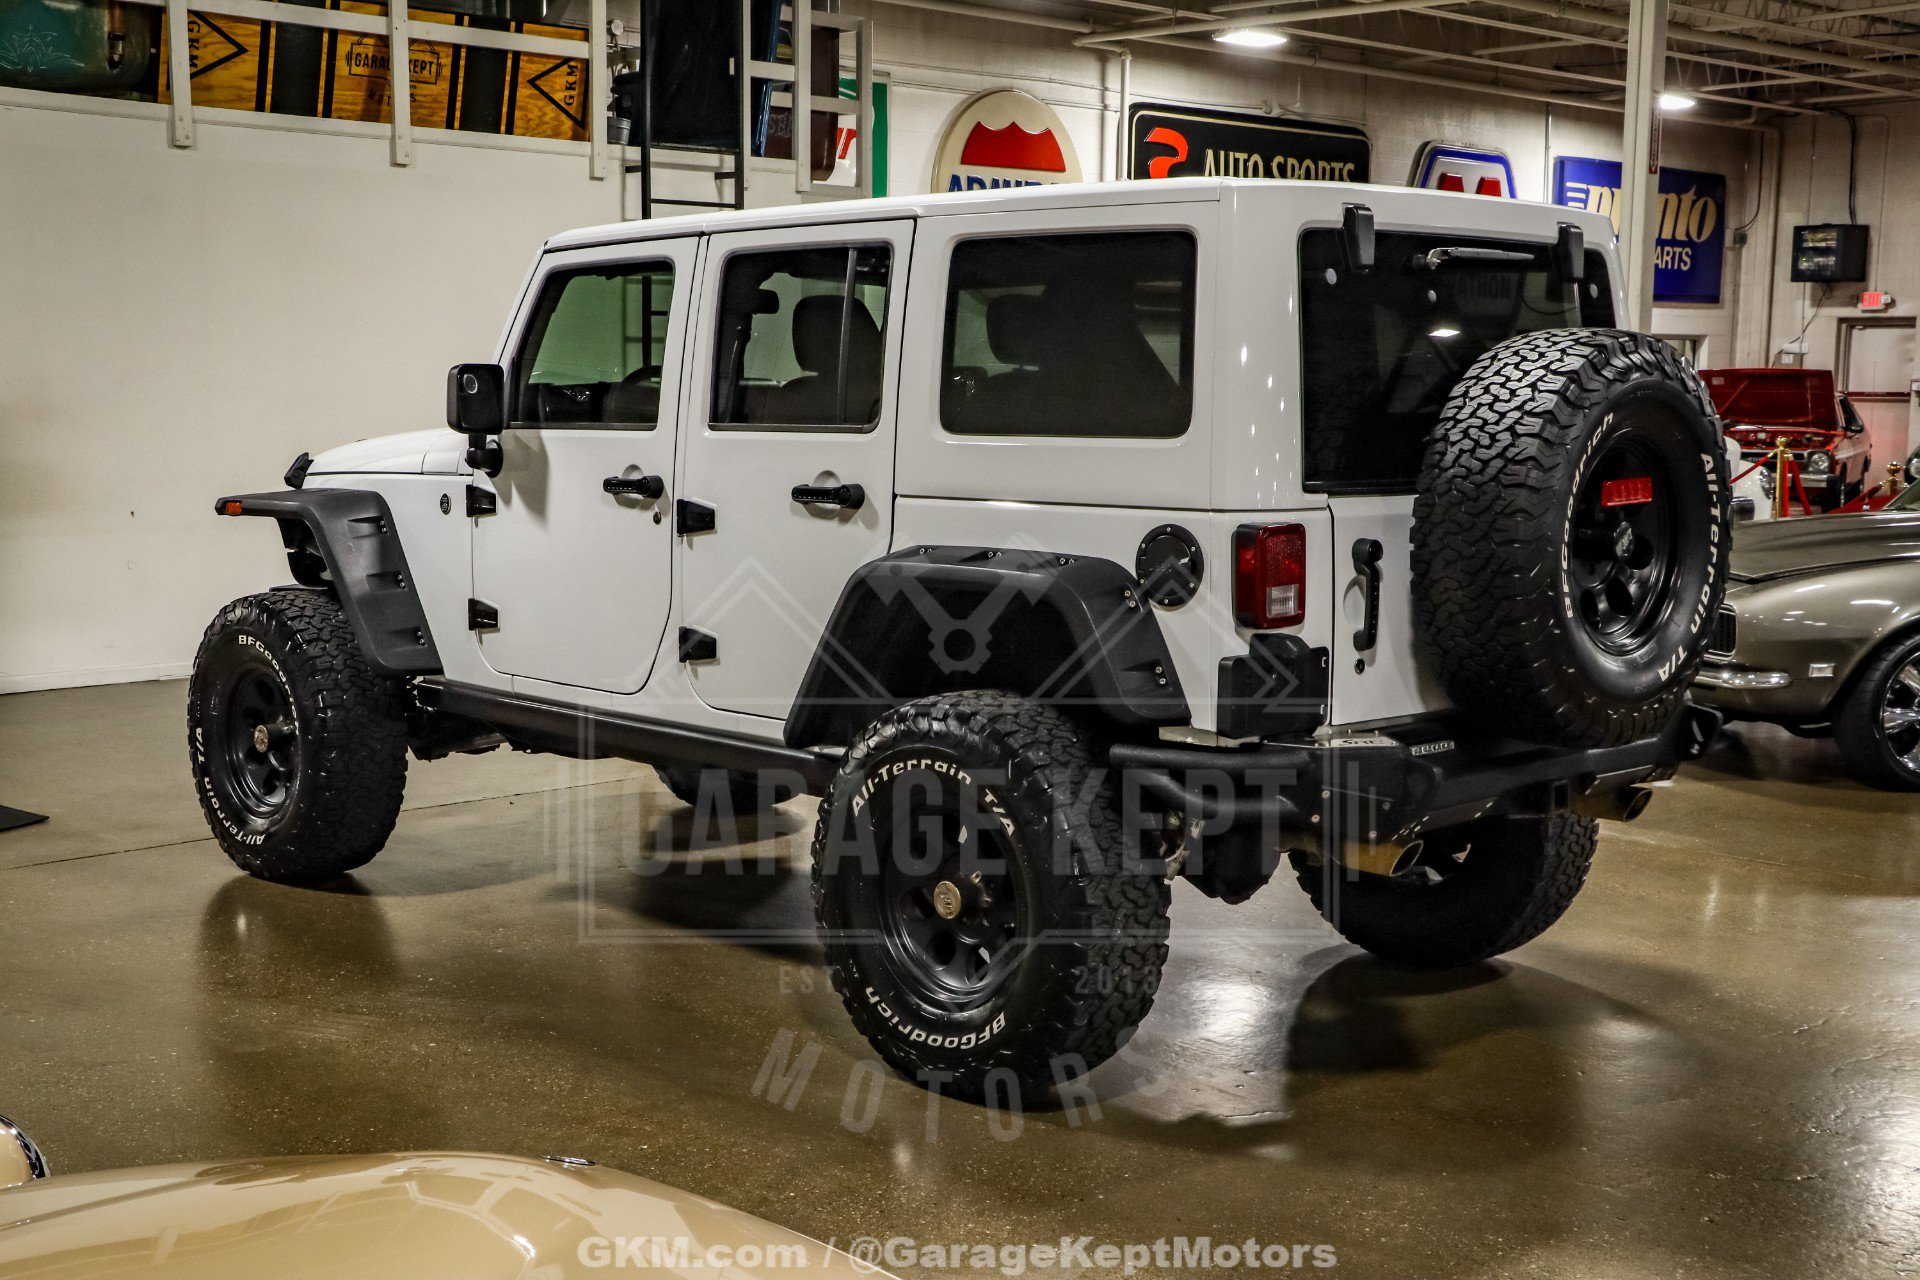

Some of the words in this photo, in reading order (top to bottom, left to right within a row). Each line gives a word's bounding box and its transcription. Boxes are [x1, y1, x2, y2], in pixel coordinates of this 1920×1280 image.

[187, 20, 200, 69] GKM
[354, 53, 390, 71] GARA
[367, 88, 417, 107] MOTS
[563, 63, 579, 106] GKM
[1205, 148, 1264, 178] AUTO
[1272, 155, 1355, 182] SPORTS
[1586, 184, 1717, 243] rnto
[1653, 245, 1692, 271] ARTS
[1561, 412, 1614, 618] BFGoodrich
[1690, 453, 1721, 634] All-Terrain
[1657, 645, 1688, 682] T/A
[203, 776, 266, 845] All-Terrain
[852, 758, 972, 817] All-Terrain
[984, 788, 1016, 837] T/A
[865, 986, 1006, 1050] BFGoodrich
